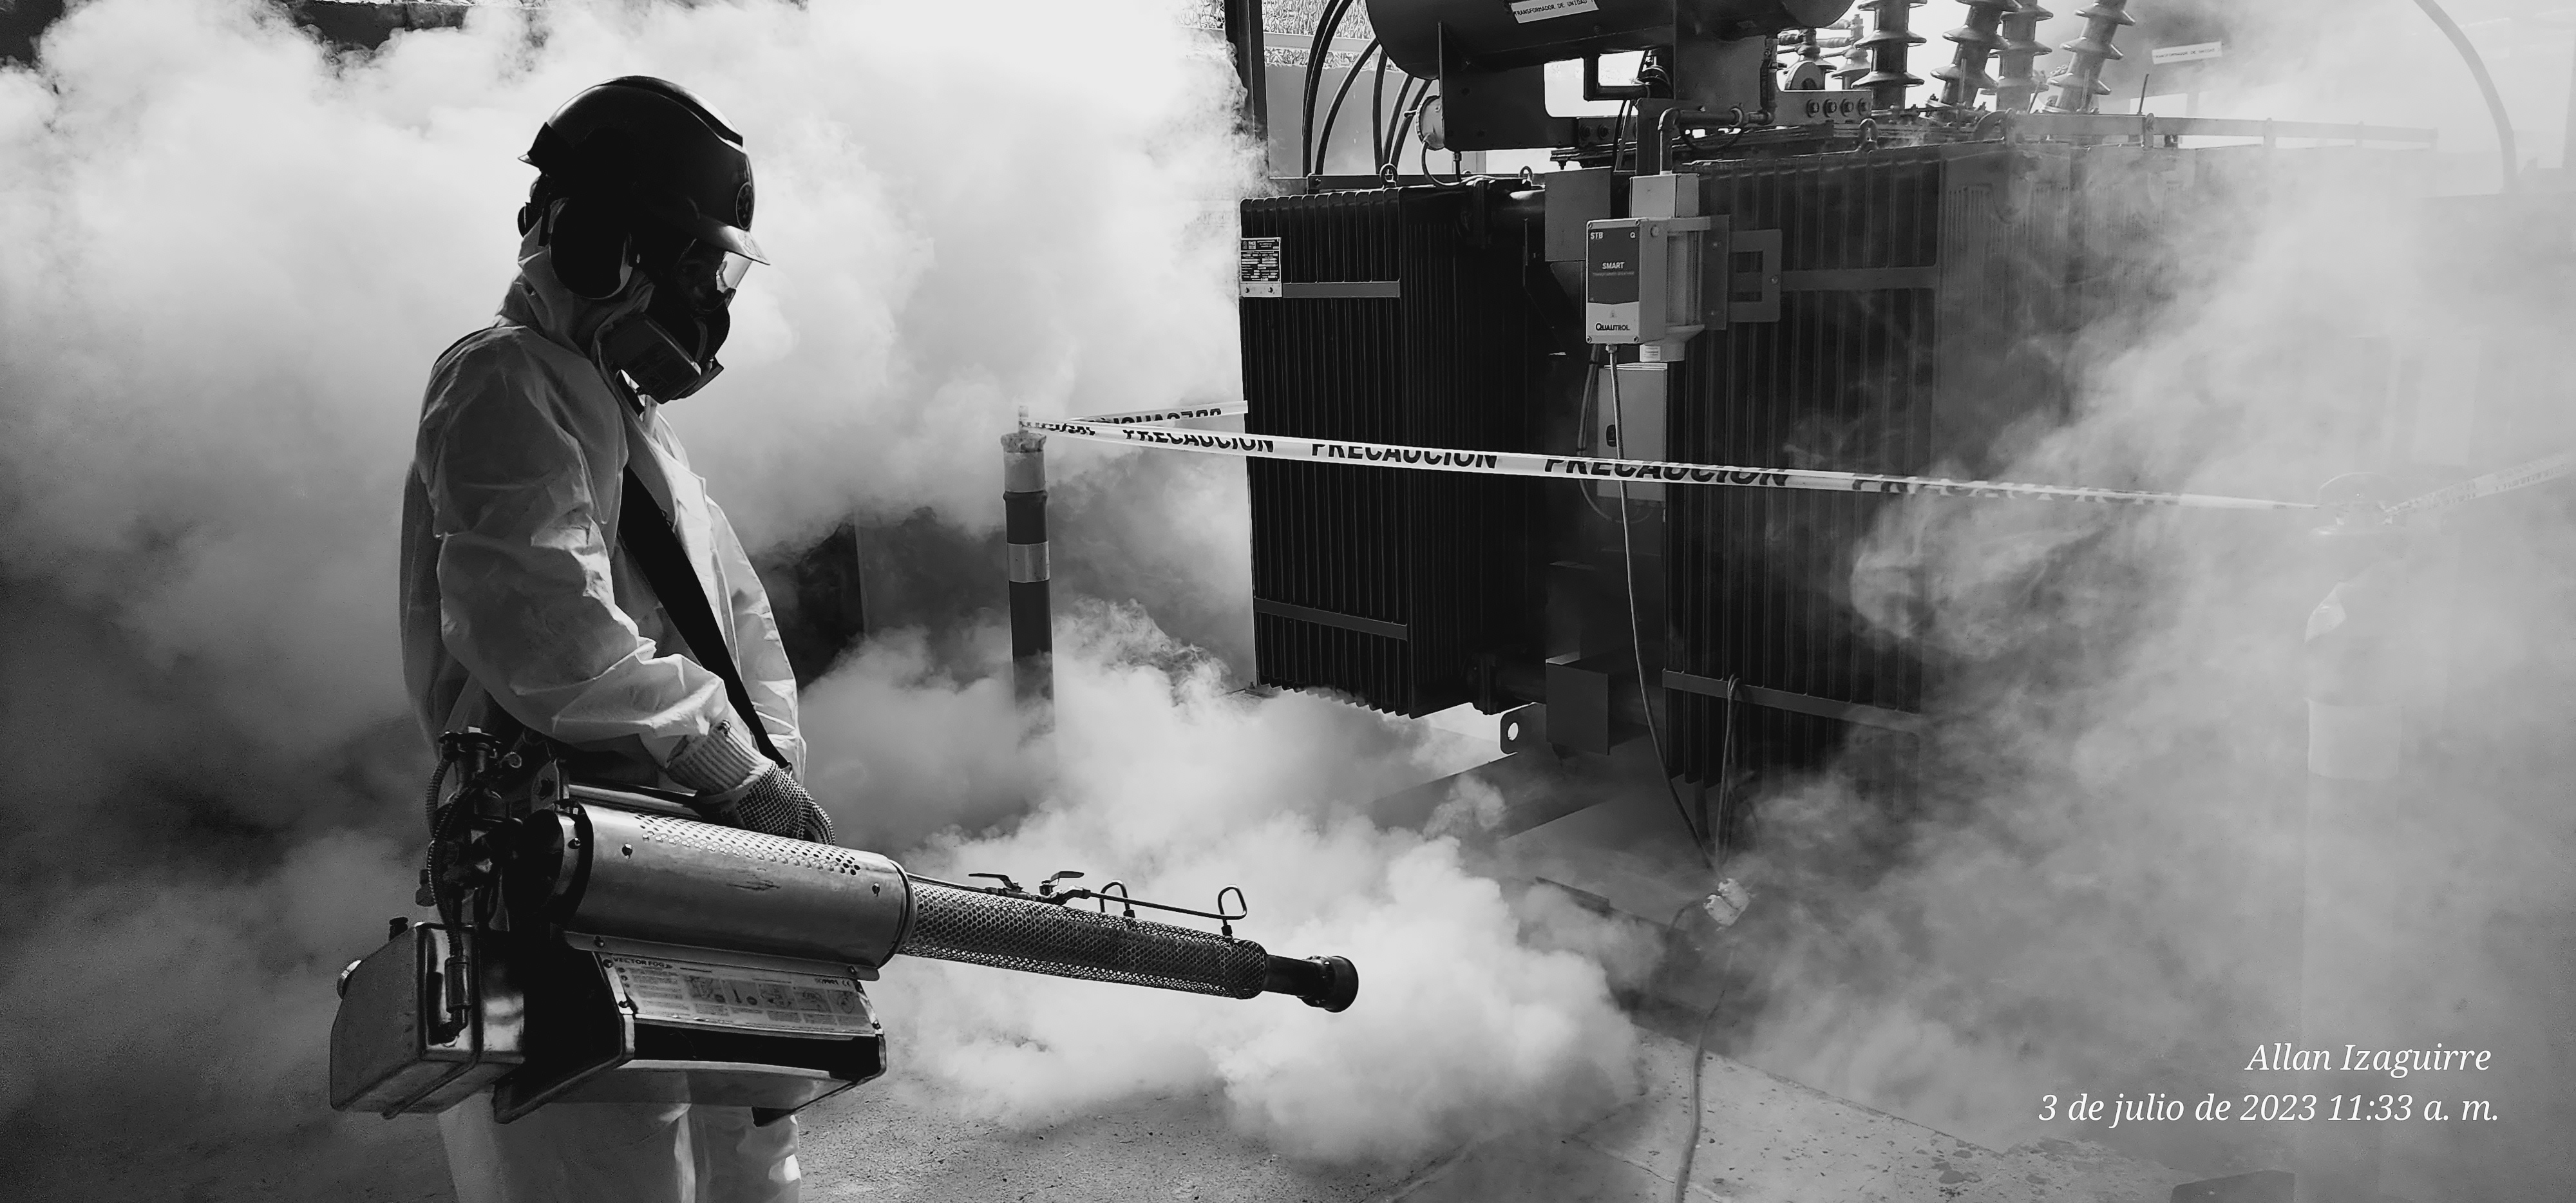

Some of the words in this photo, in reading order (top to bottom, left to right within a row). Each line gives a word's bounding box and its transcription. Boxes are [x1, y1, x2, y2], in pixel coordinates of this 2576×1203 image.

[1513, 5, 1555, 15] TRANSFORMADOR
[1602, 261, 1625, 270] SMART
[1595, 323, 1630, 331] QUALITROL
[1312, 443, 1497, 469] PRECAUCION
